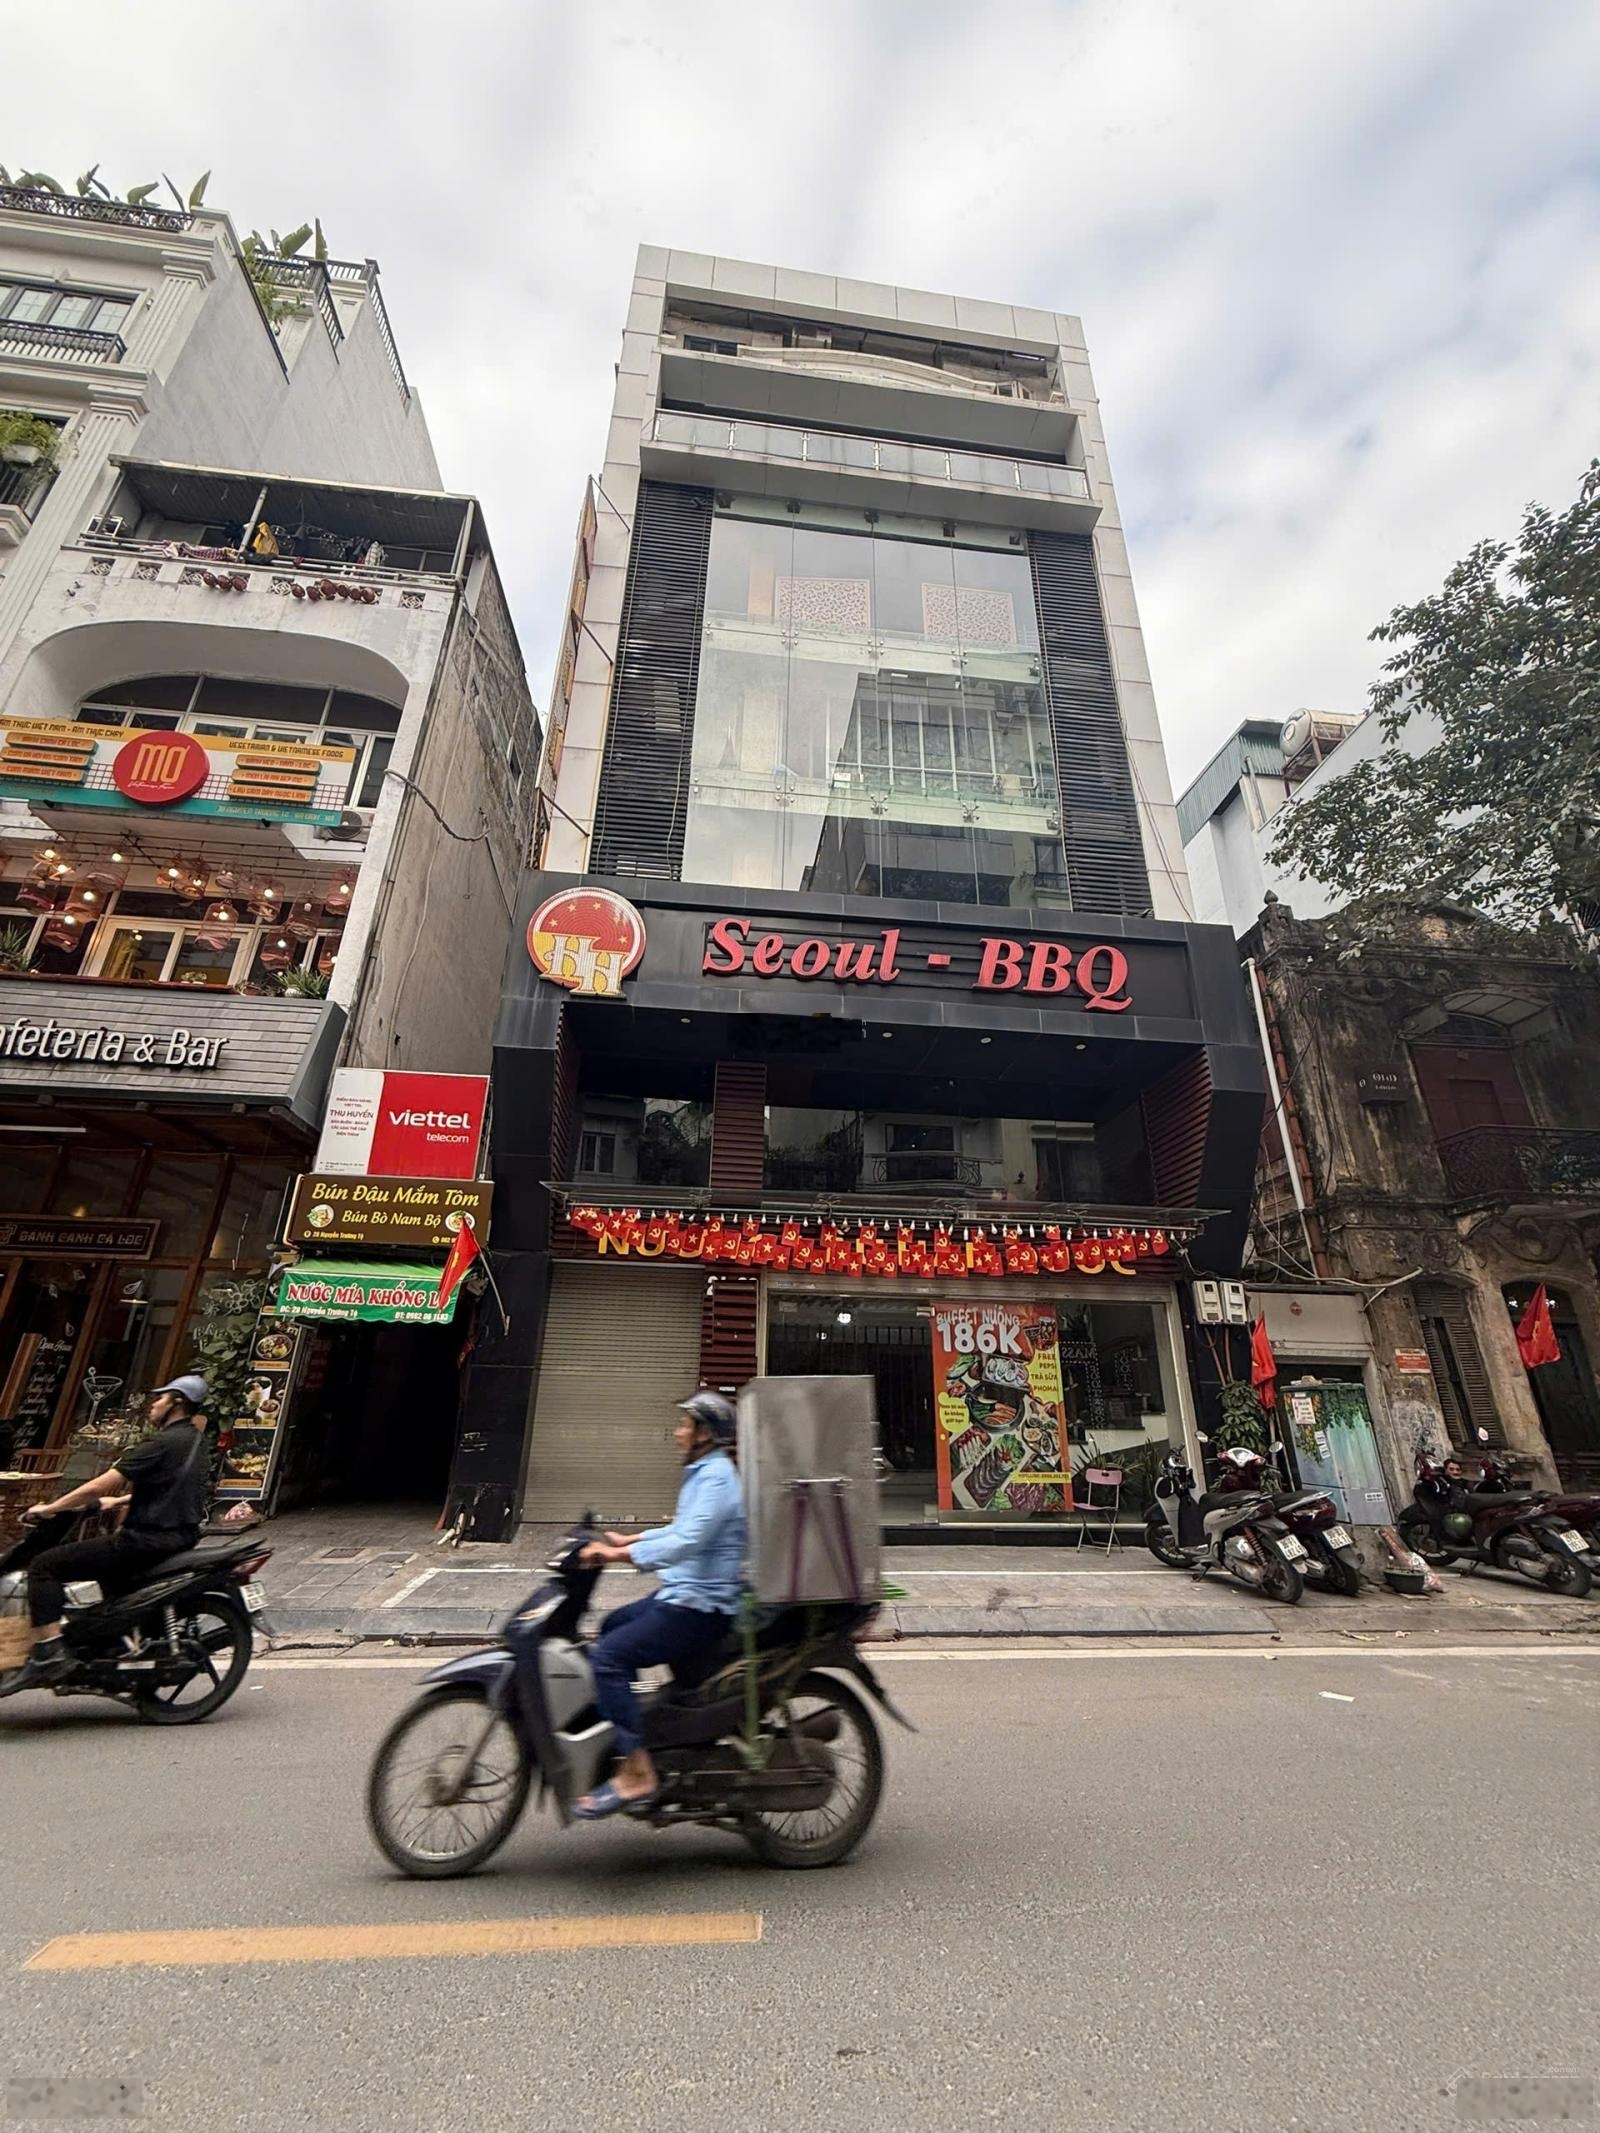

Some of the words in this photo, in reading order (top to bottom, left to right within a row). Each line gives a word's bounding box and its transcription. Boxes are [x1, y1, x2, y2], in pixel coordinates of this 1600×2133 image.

[229, 741, 271, 751] VEGETARIAN
[277, 746, 321, 756] VIETNAMESE
[321, 750, 344, 758] FOODS
[702, 918, 901, 982] Seoul
[927, 952, 951, 969] -
[972, 937, 1134, 1013] BBQ
[133, 1033, 156, 1063] &
[165, 1028, 230, 1067] Bar
[389, 1108, 471, 1130] viettel
[427, 1132, 469, 1144] telecom
[312, 1183, 349, 1201] Bún
[352, 1186, 389, 1205] Đậu
[393, 1184, 440, 1205] Mắm
[445, 1189, 480, 1207] Tôm
[342, 1210, 367, 1224] Bún
[371, 1211, 388, 1225] Bò
[390, 1213, 421, 1226] Nam
[424, 1214, 441, 1228] Bộ
[287, 1280, 332, 1303] NƯỚC
[334, 1282, 365, 1305] MÍA
[369, 1281, 425, 1307] KHỔNG
[936, 1307, 978, 1325] BUFFET
[937, 1323, 1023, 1354] 186K
[1031, 1372, 1043, 1380] TRÀ
